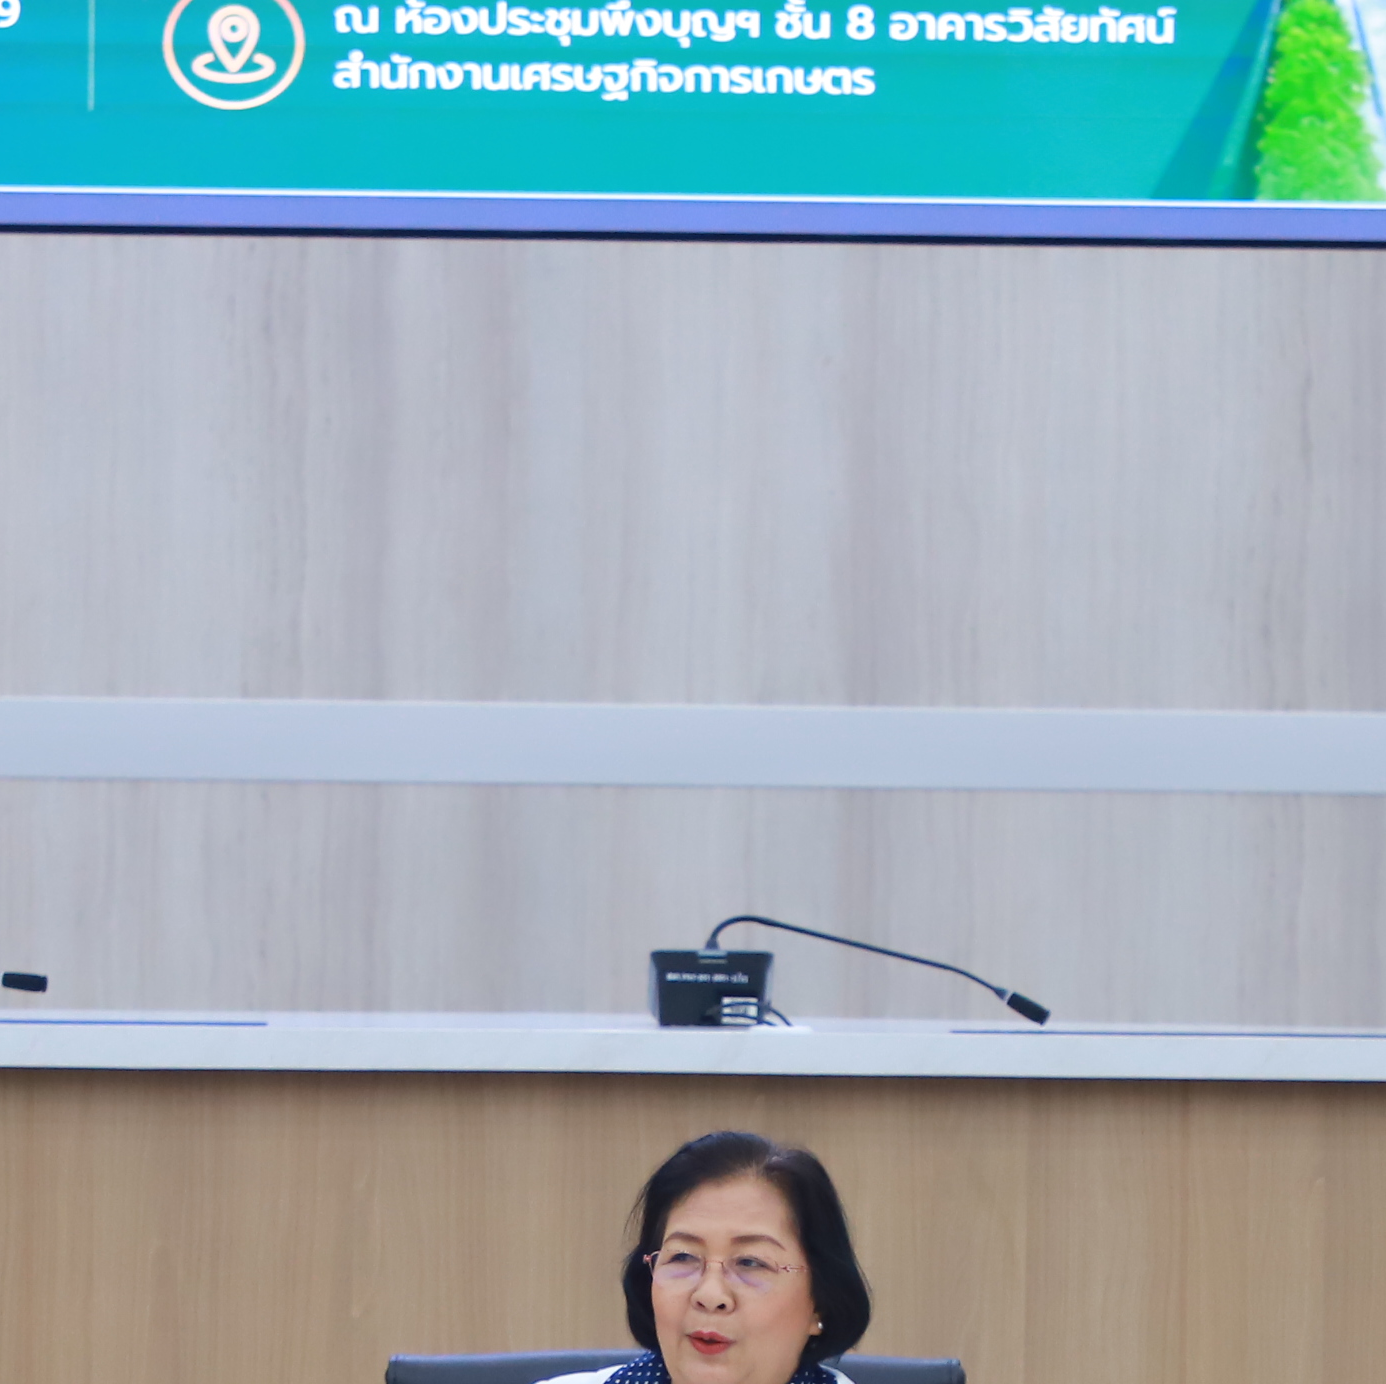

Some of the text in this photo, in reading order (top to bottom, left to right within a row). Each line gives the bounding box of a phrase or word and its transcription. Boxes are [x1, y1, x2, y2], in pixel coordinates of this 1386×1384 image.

[334, 5, 379, 34] ณ
[847, 5, 876, 41] 8
[888, 6, 1178, 44] อาคารวิสัยทัศน์
[332, 49, 876, 101] สำนักงานเศรษฐกิจการเกษตร
